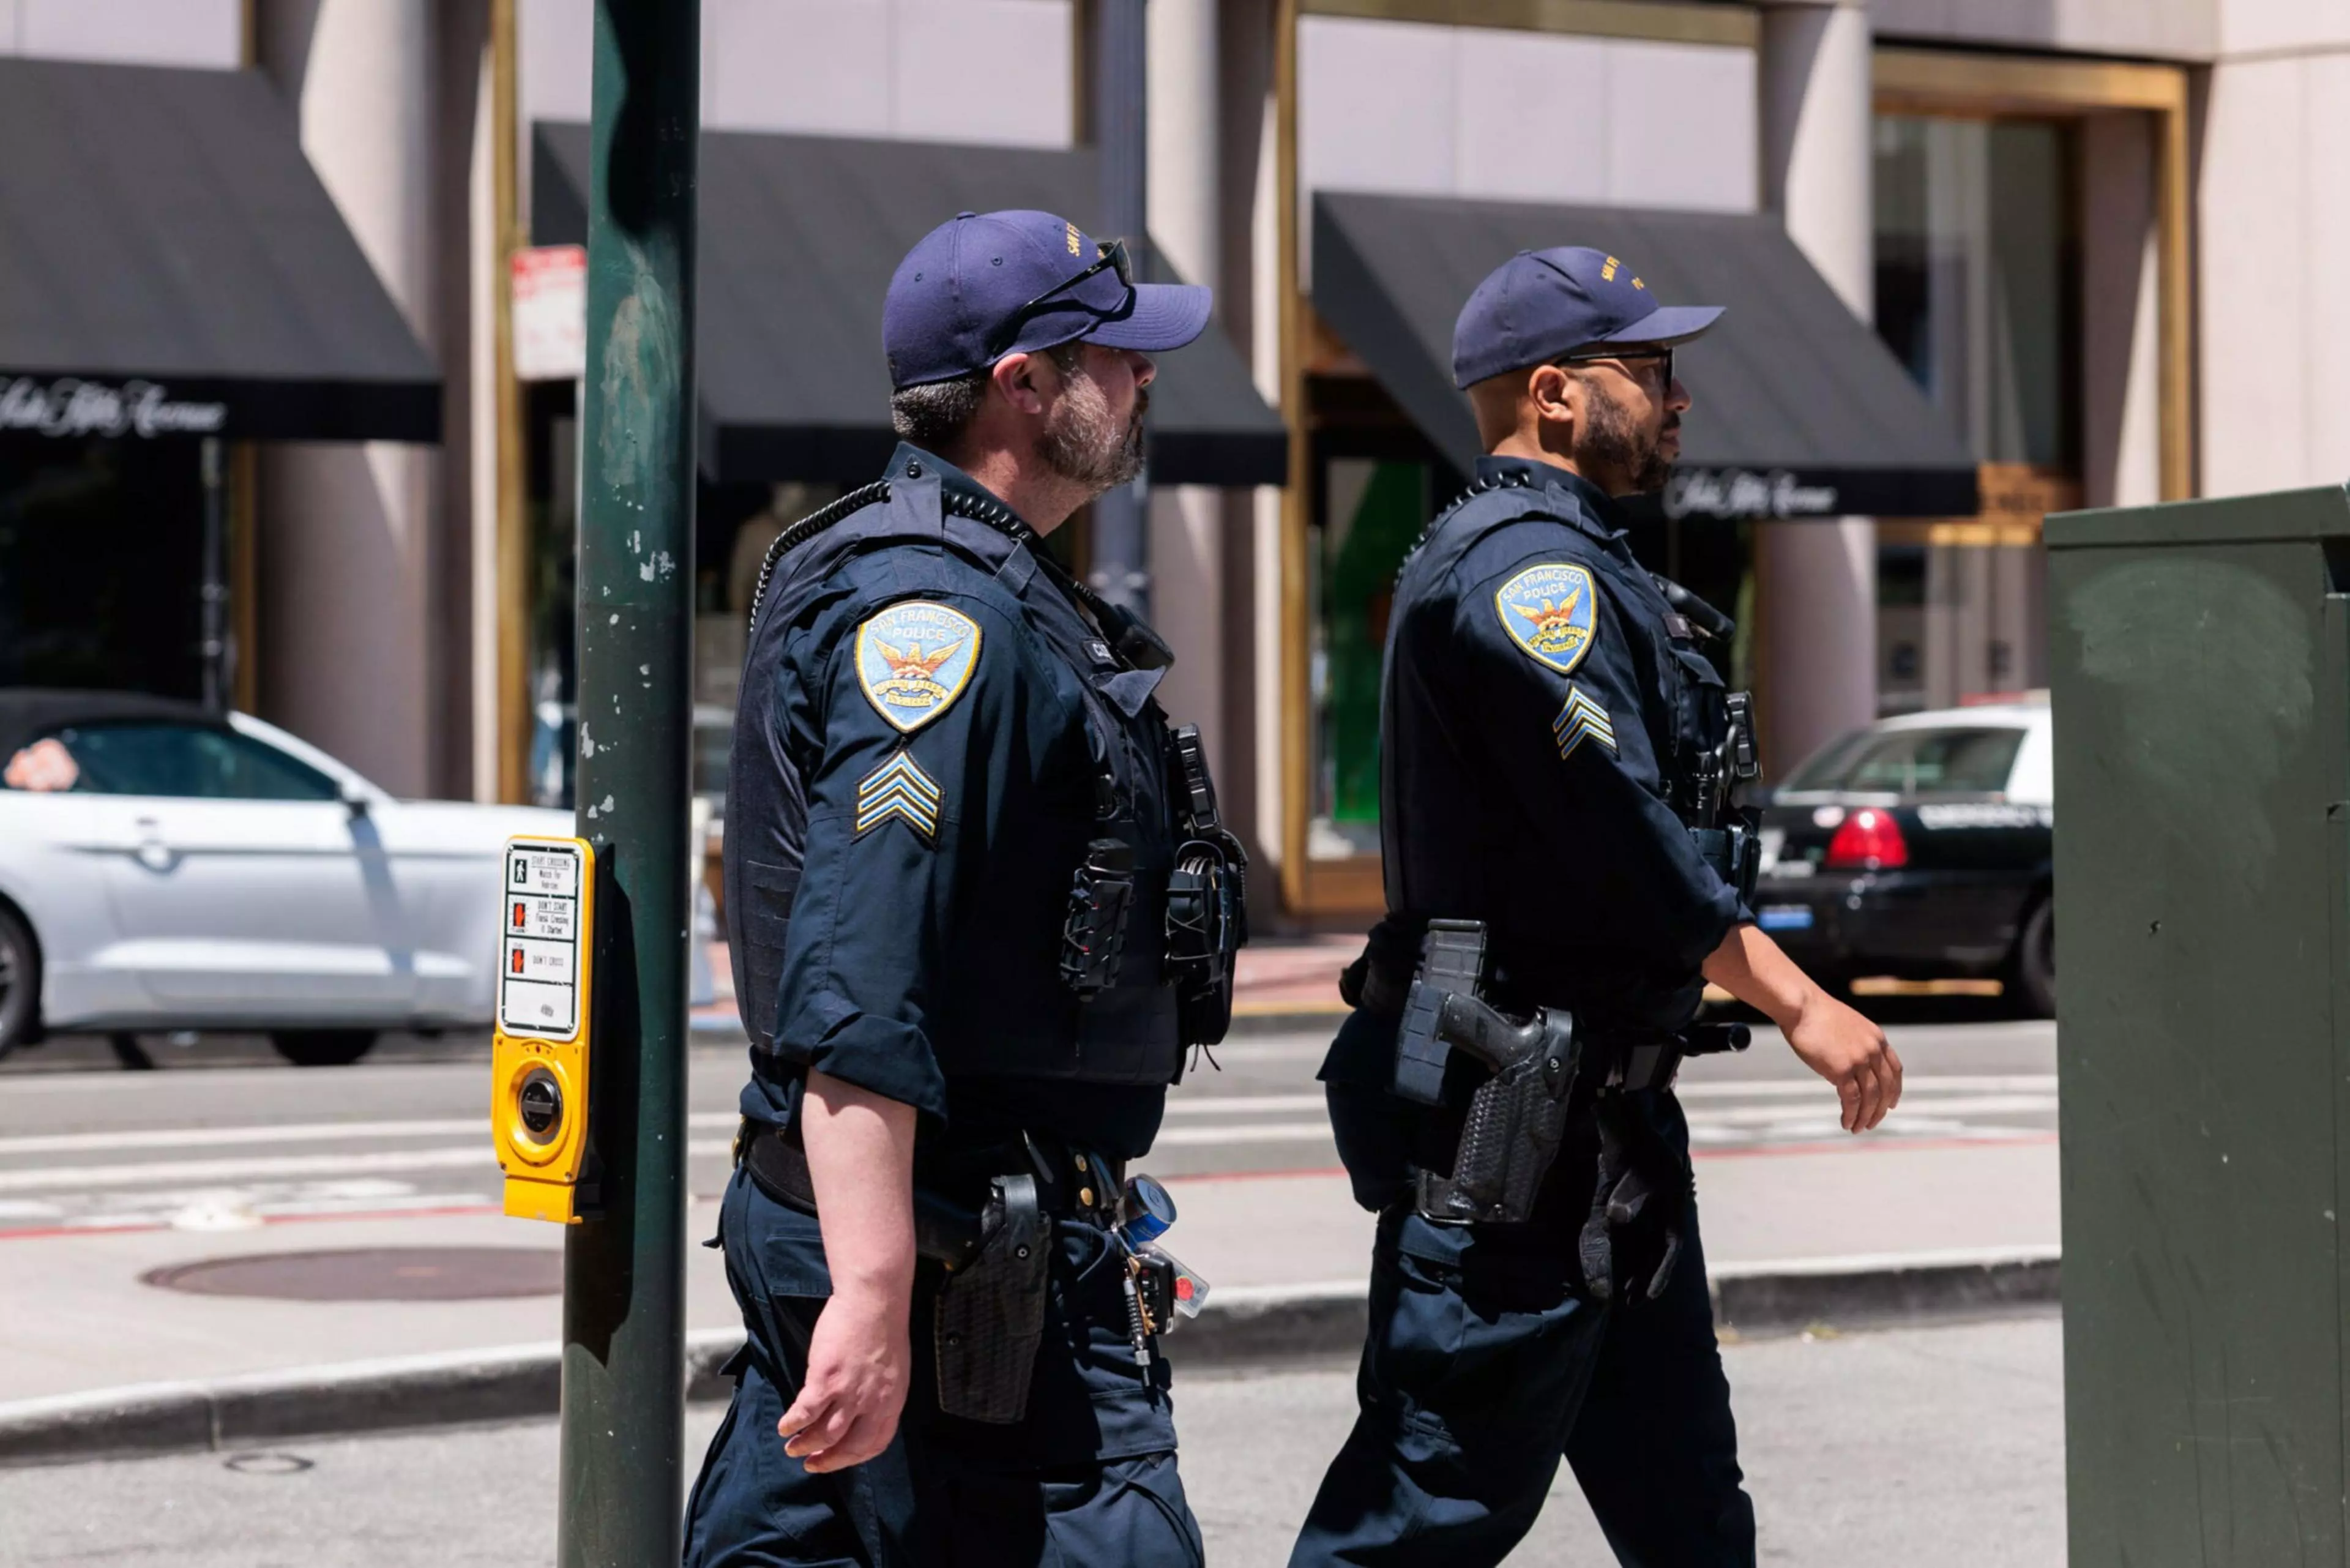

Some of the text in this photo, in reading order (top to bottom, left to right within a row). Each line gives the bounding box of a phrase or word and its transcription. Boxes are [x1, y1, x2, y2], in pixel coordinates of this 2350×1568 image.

[1502, 569, 1583, 602] SAN FRANCISCO
[1523, 581, 1567, 601] POLICE
[869, 610, 971, 638] SAN FRANCISCO
[892, 627, 946, 641] POLICE
